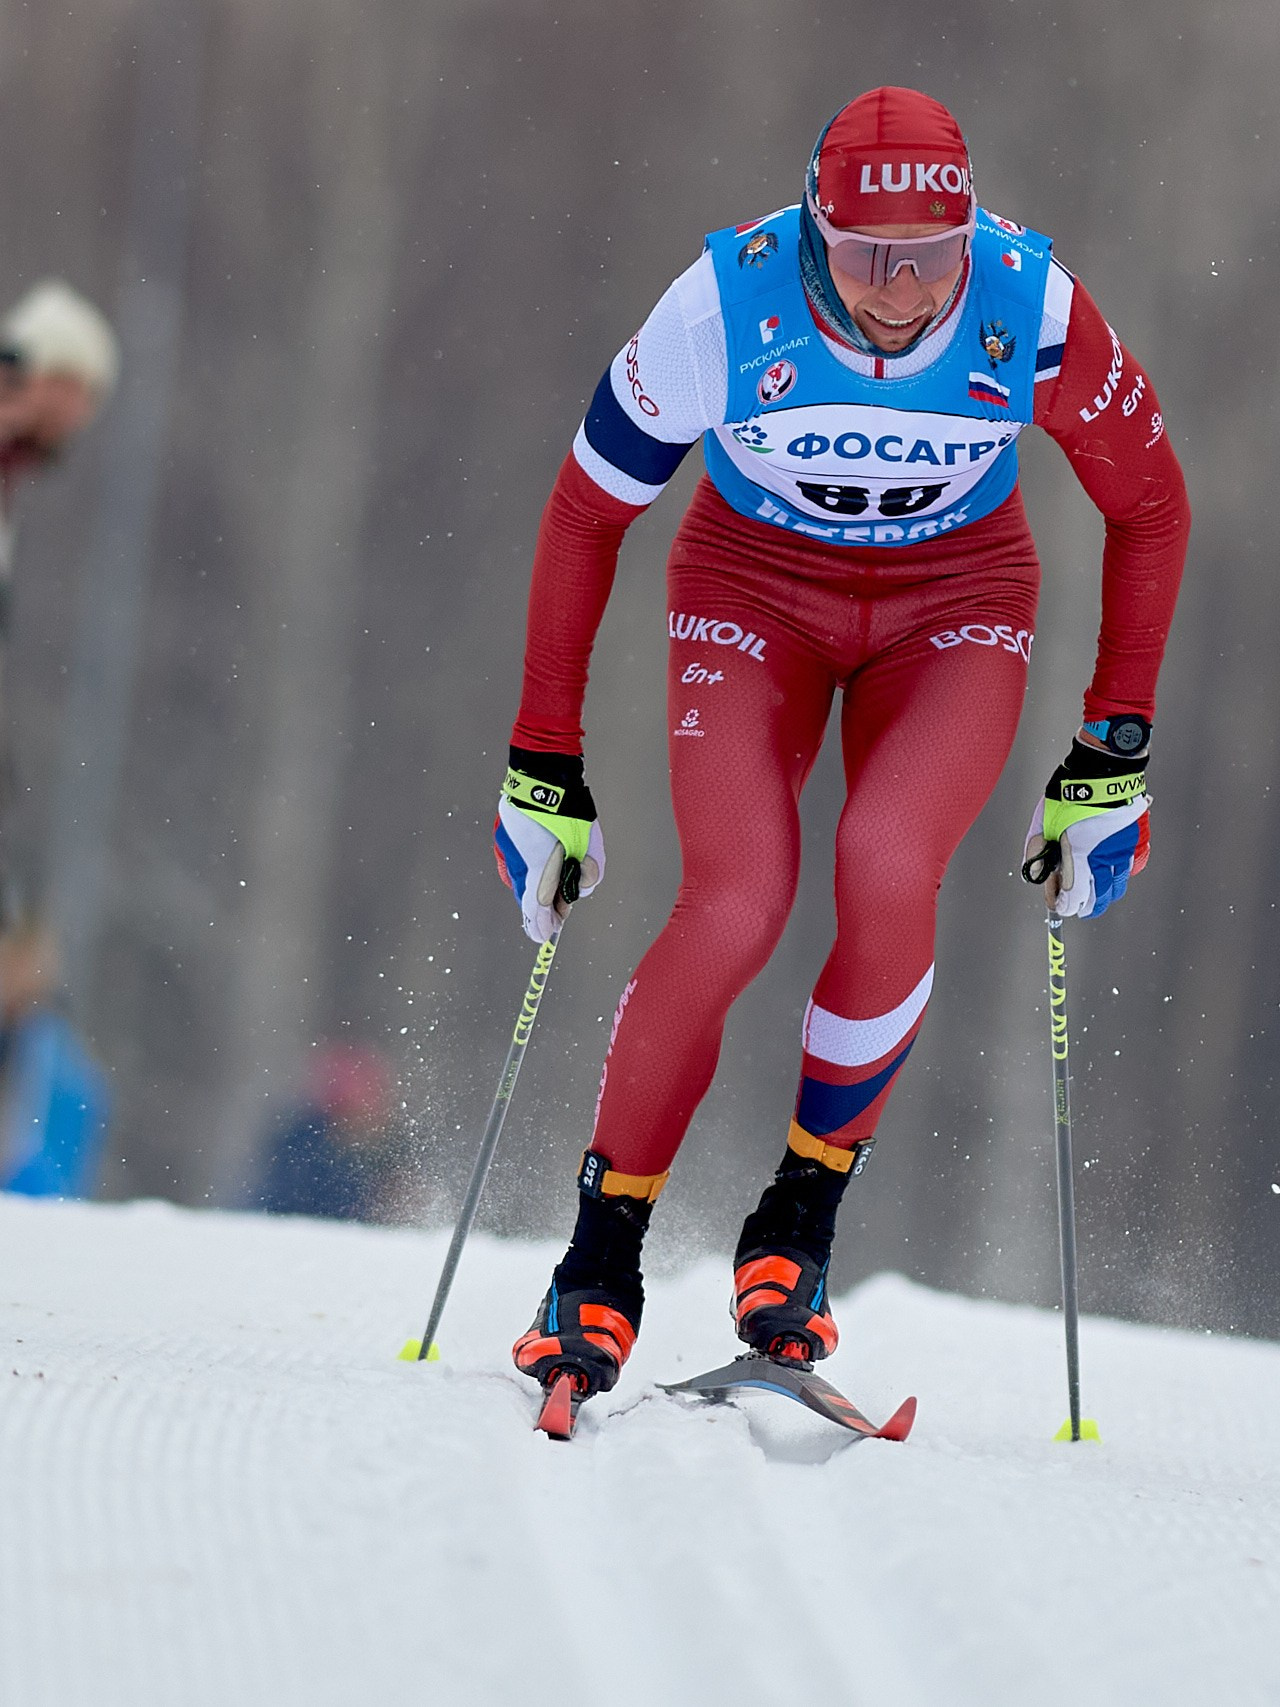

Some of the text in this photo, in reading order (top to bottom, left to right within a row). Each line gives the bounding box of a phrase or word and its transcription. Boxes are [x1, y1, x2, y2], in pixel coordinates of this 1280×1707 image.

[626, 331, 660, 417] OSCO
[740, 336, 810, 374] РУСКЛИМАТ
[668, 611, 767, 662] LUKOIL
[583, 1155, 598, 1188] 260
